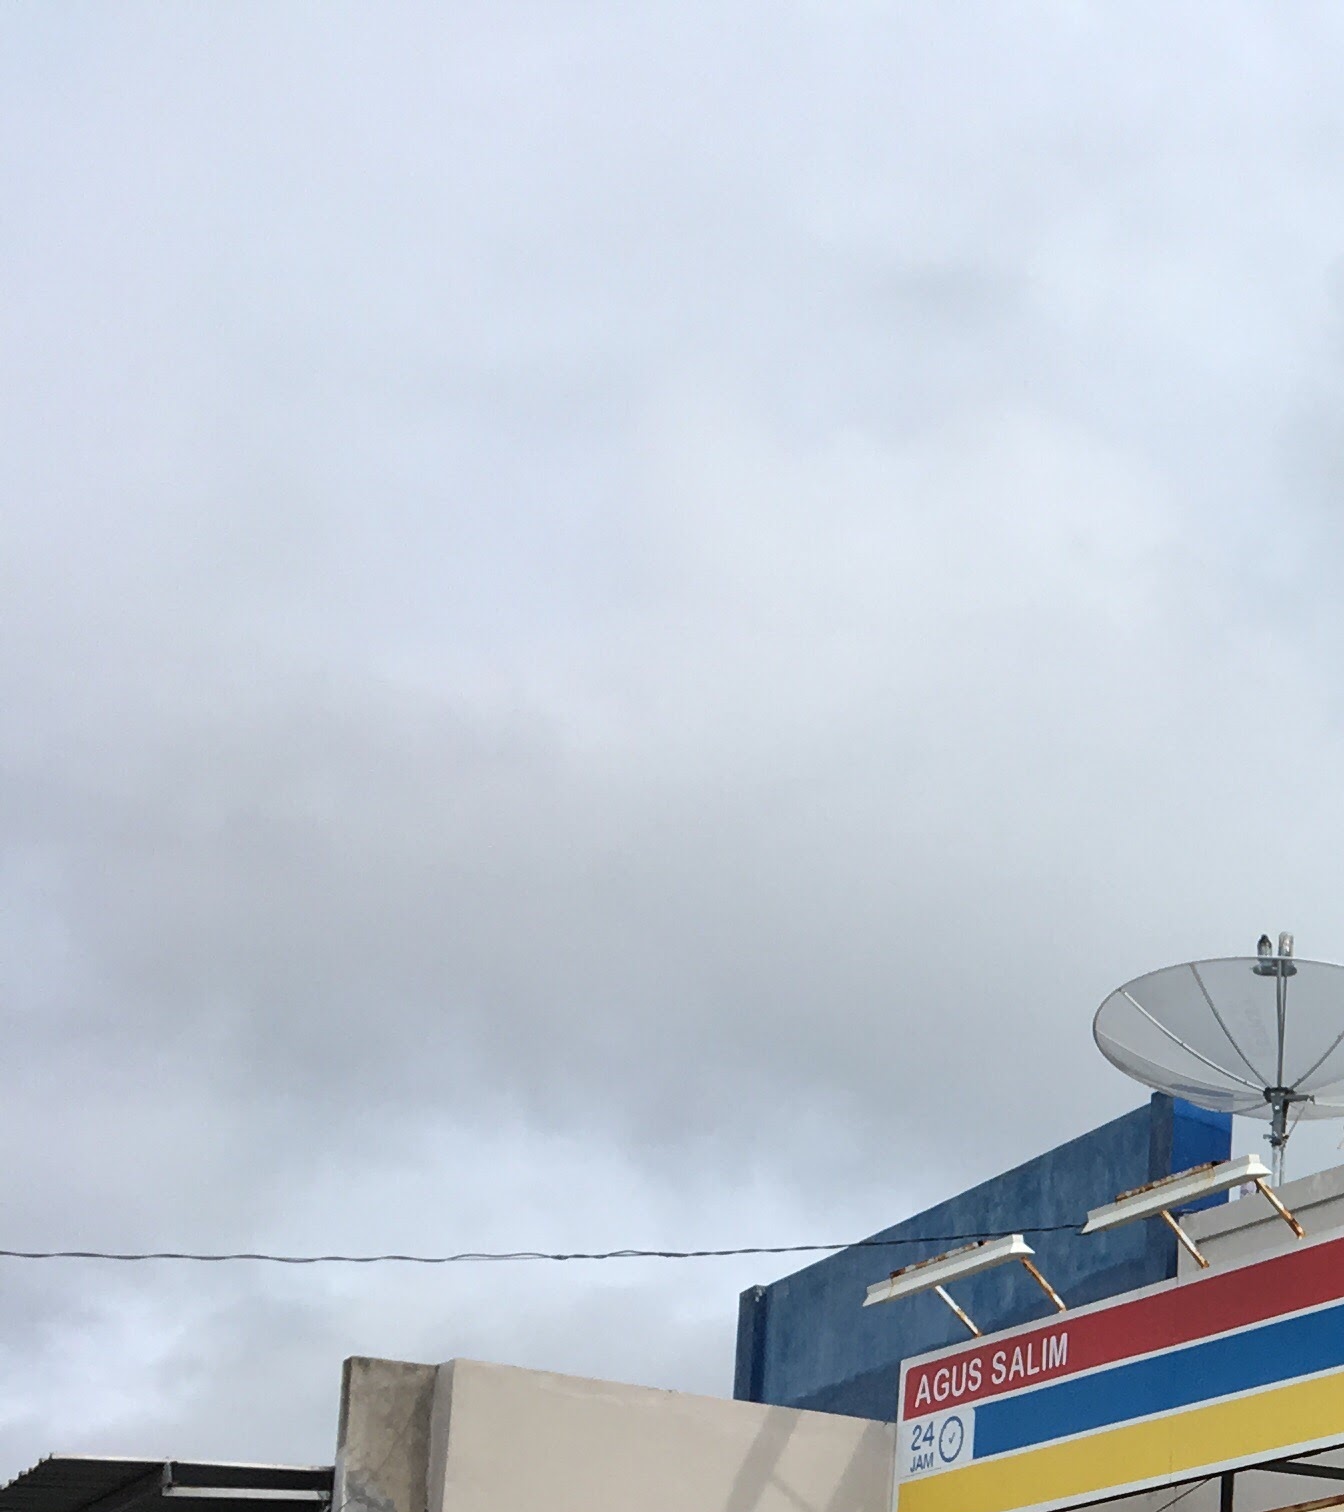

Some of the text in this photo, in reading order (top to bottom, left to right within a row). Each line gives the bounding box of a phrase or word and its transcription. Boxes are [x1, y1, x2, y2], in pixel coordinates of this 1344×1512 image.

[913, 1332, 1068, 1409] AGUS SALIM
[910, 1421, 935, 1451] 24
[909, 1452, 934, 1473] JAM
